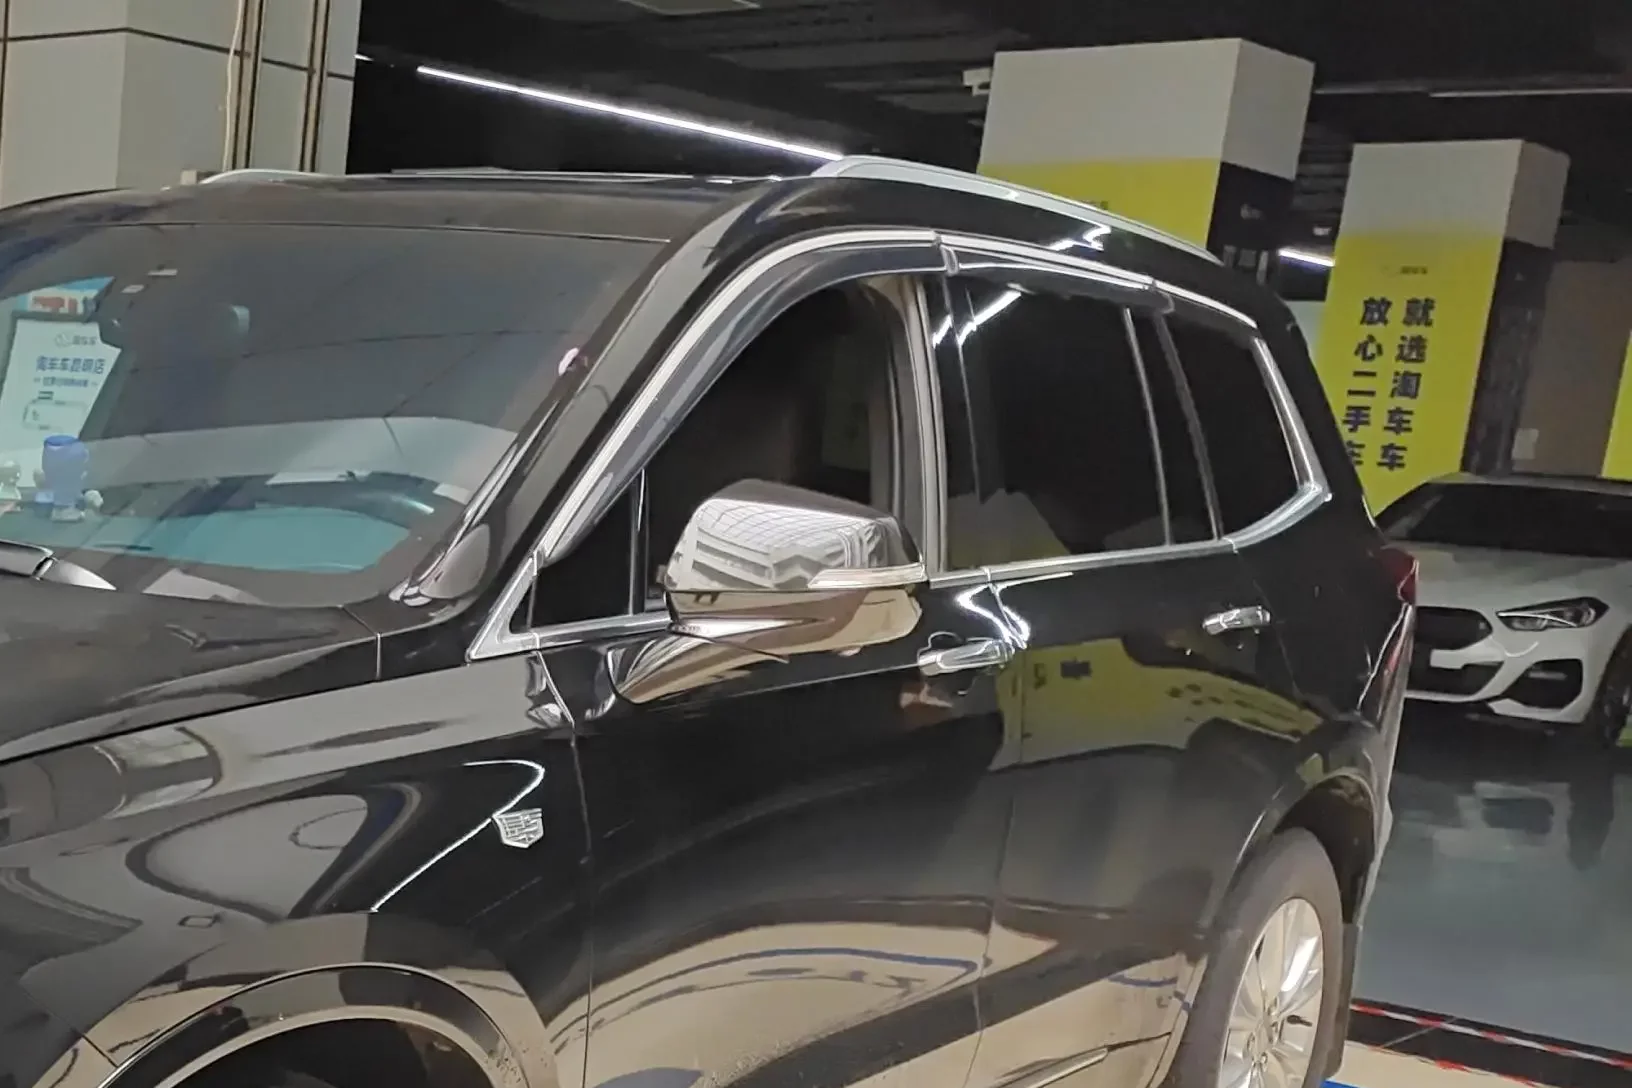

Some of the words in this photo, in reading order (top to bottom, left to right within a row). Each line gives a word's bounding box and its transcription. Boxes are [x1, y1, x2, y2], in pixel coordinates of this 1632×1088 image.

[1377, 298, 1435, 472] 就选淘车车
